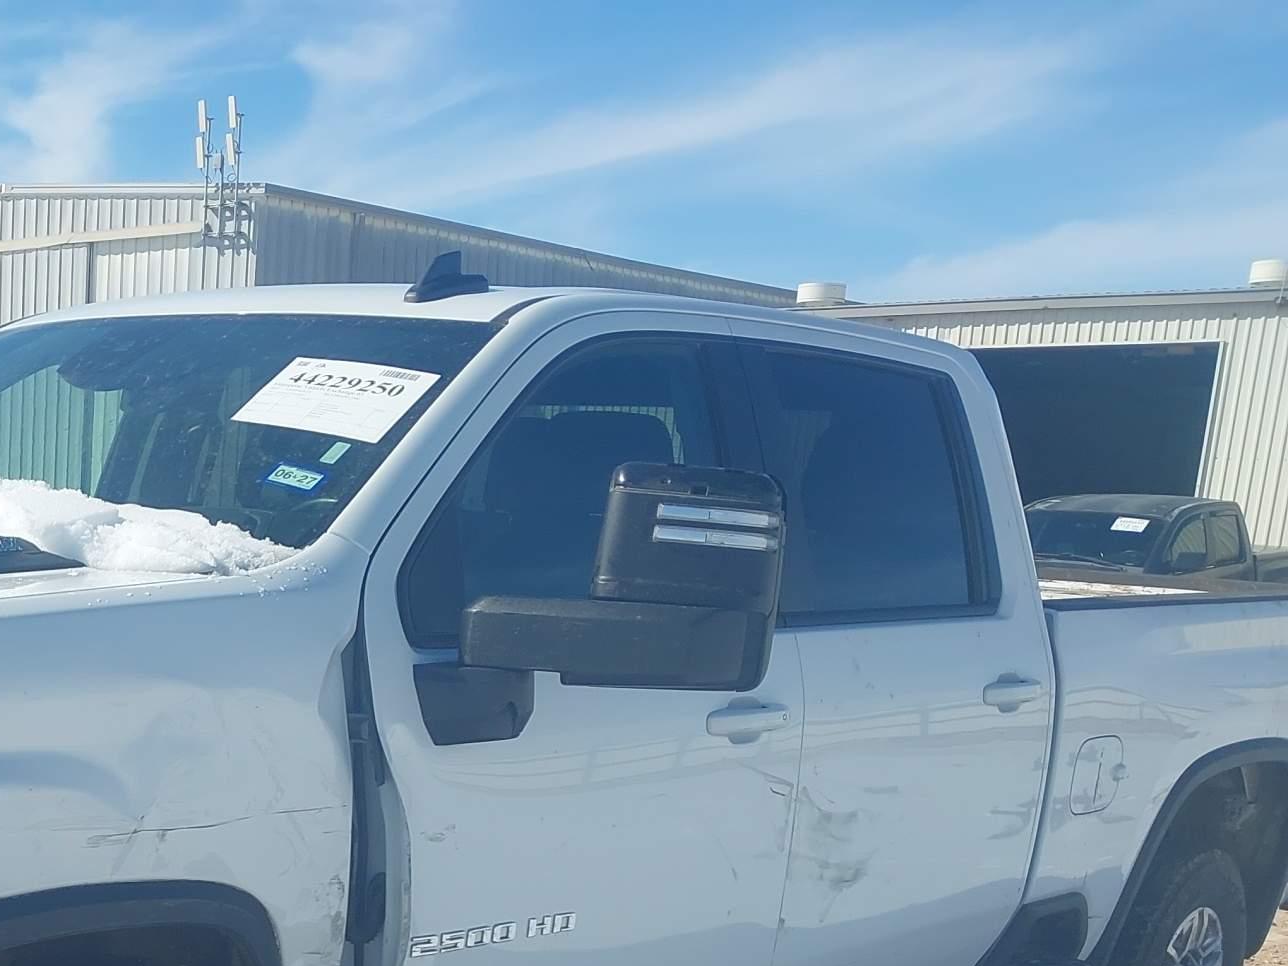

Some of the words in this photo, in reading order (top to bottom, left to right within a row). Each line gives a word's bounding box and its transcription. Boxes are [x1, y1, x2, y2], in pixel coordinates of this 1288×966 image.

[289, 371, 405, 397] 44229250
[410, 920, 517, 957] 2500
[527, 912, 576, 938] HD
